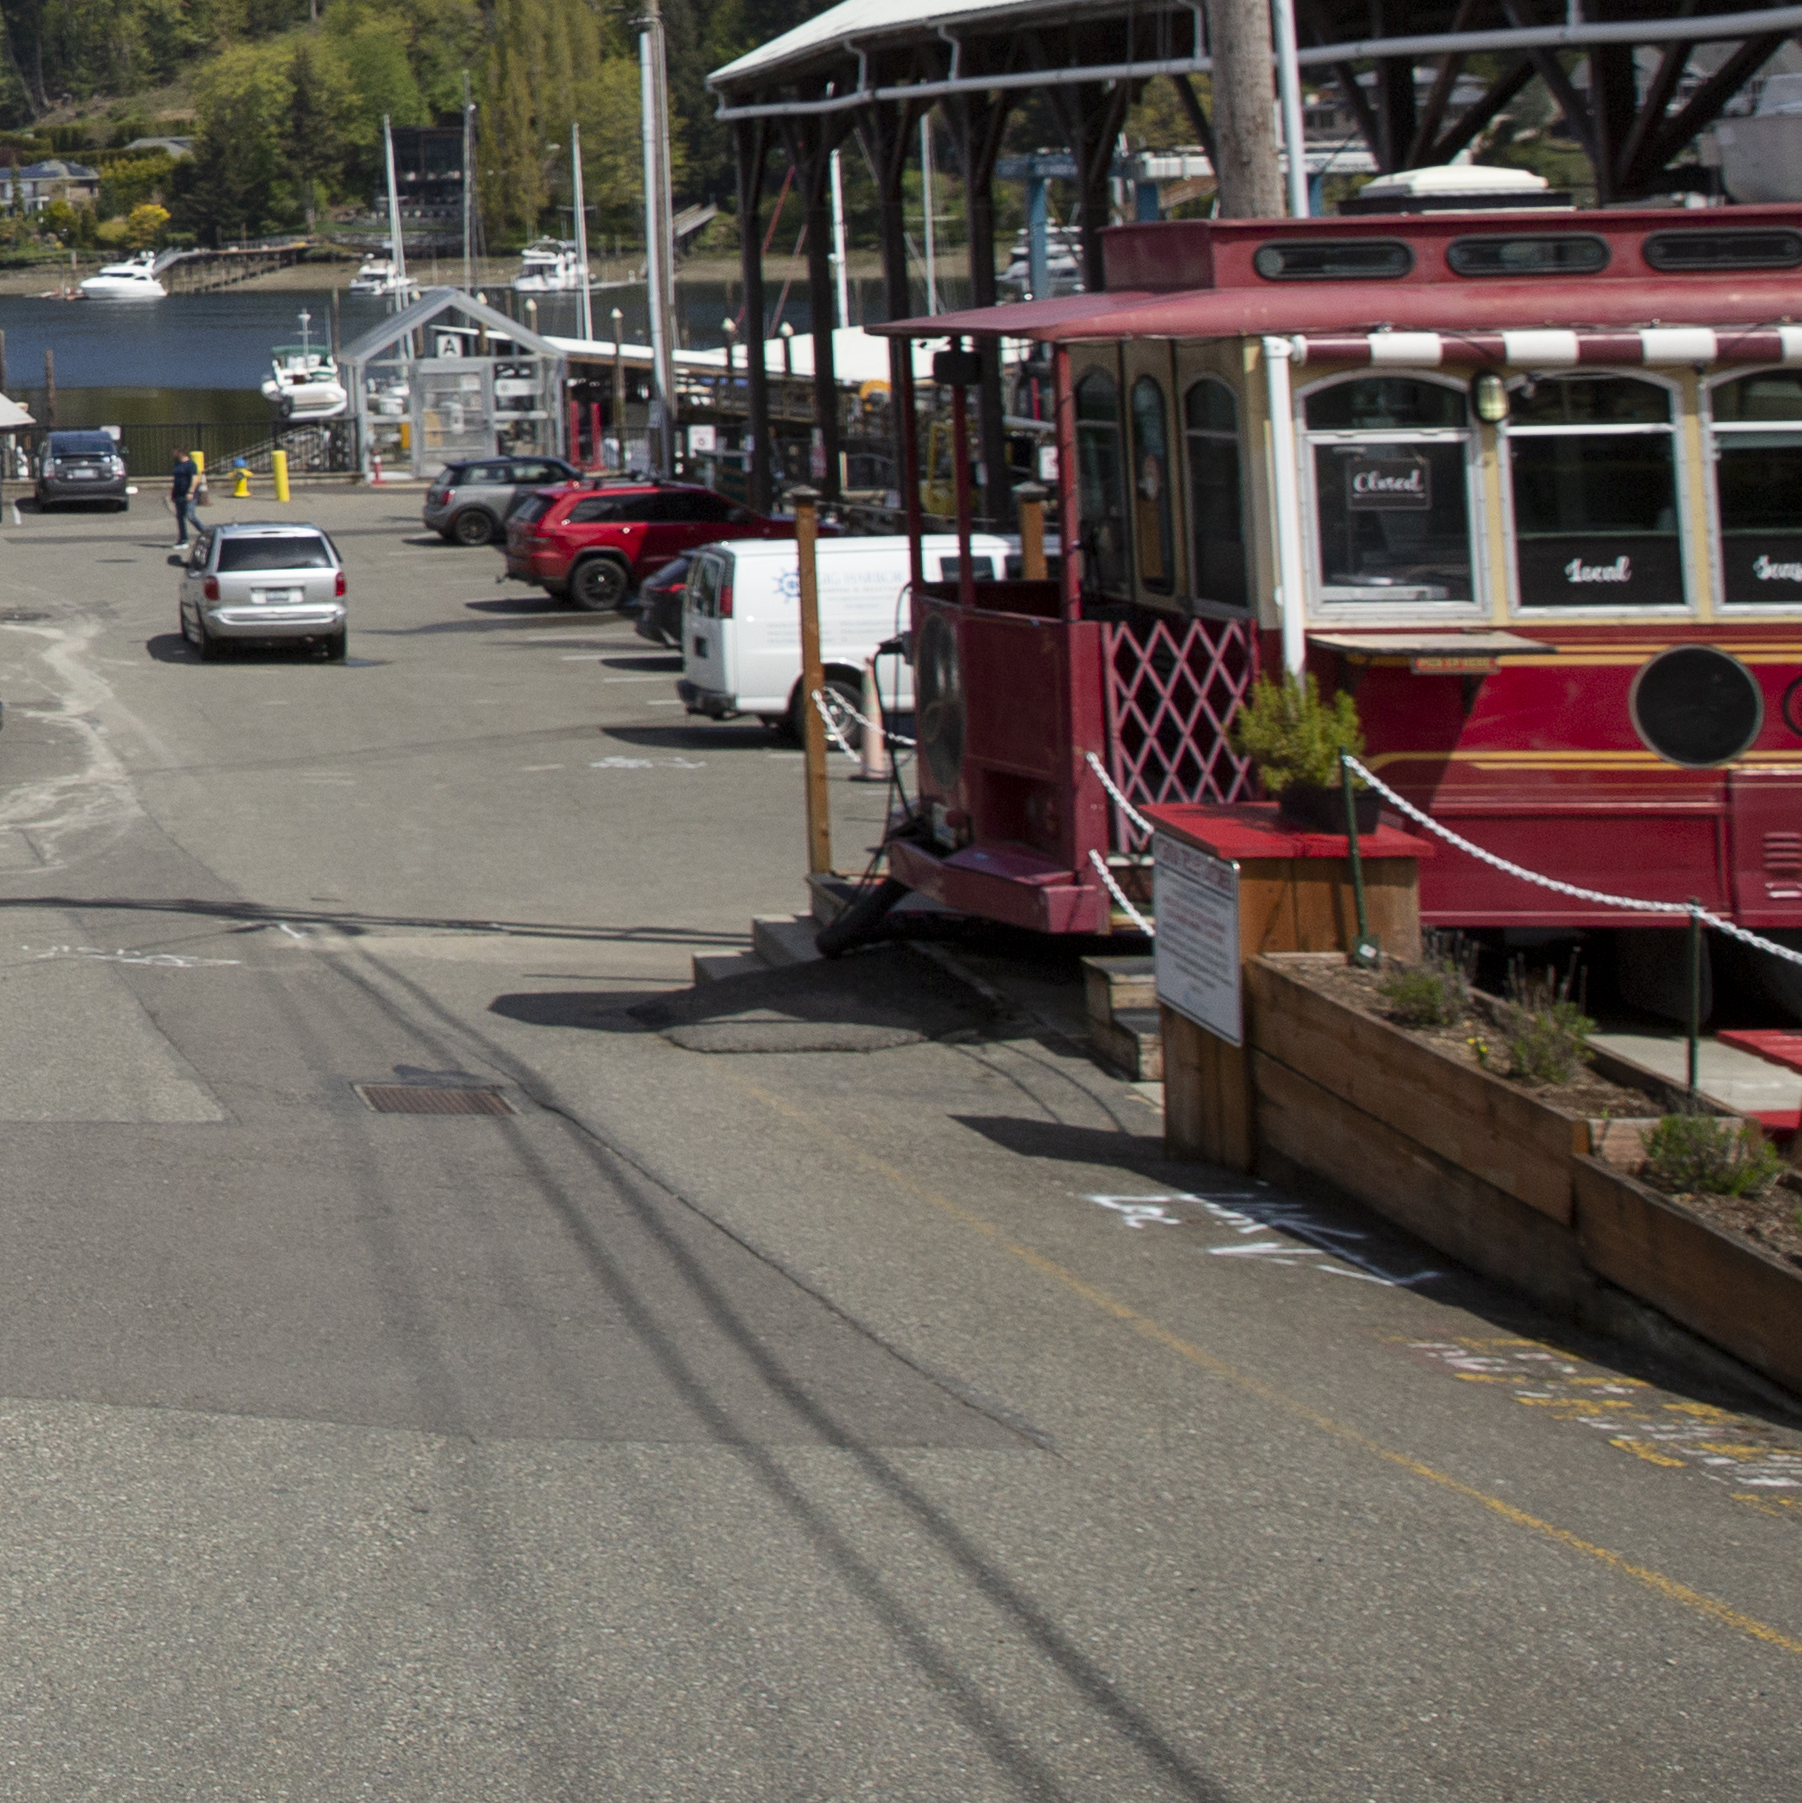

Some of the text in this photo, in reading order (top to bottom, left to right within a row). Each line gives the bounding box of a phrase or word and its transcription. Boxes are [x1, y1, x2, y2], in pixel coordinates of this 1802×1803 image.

[444, 339, 457, 355] A
[1353, 469, 1424, 492] Closed
[1564, 555, 1632, 583] Local
